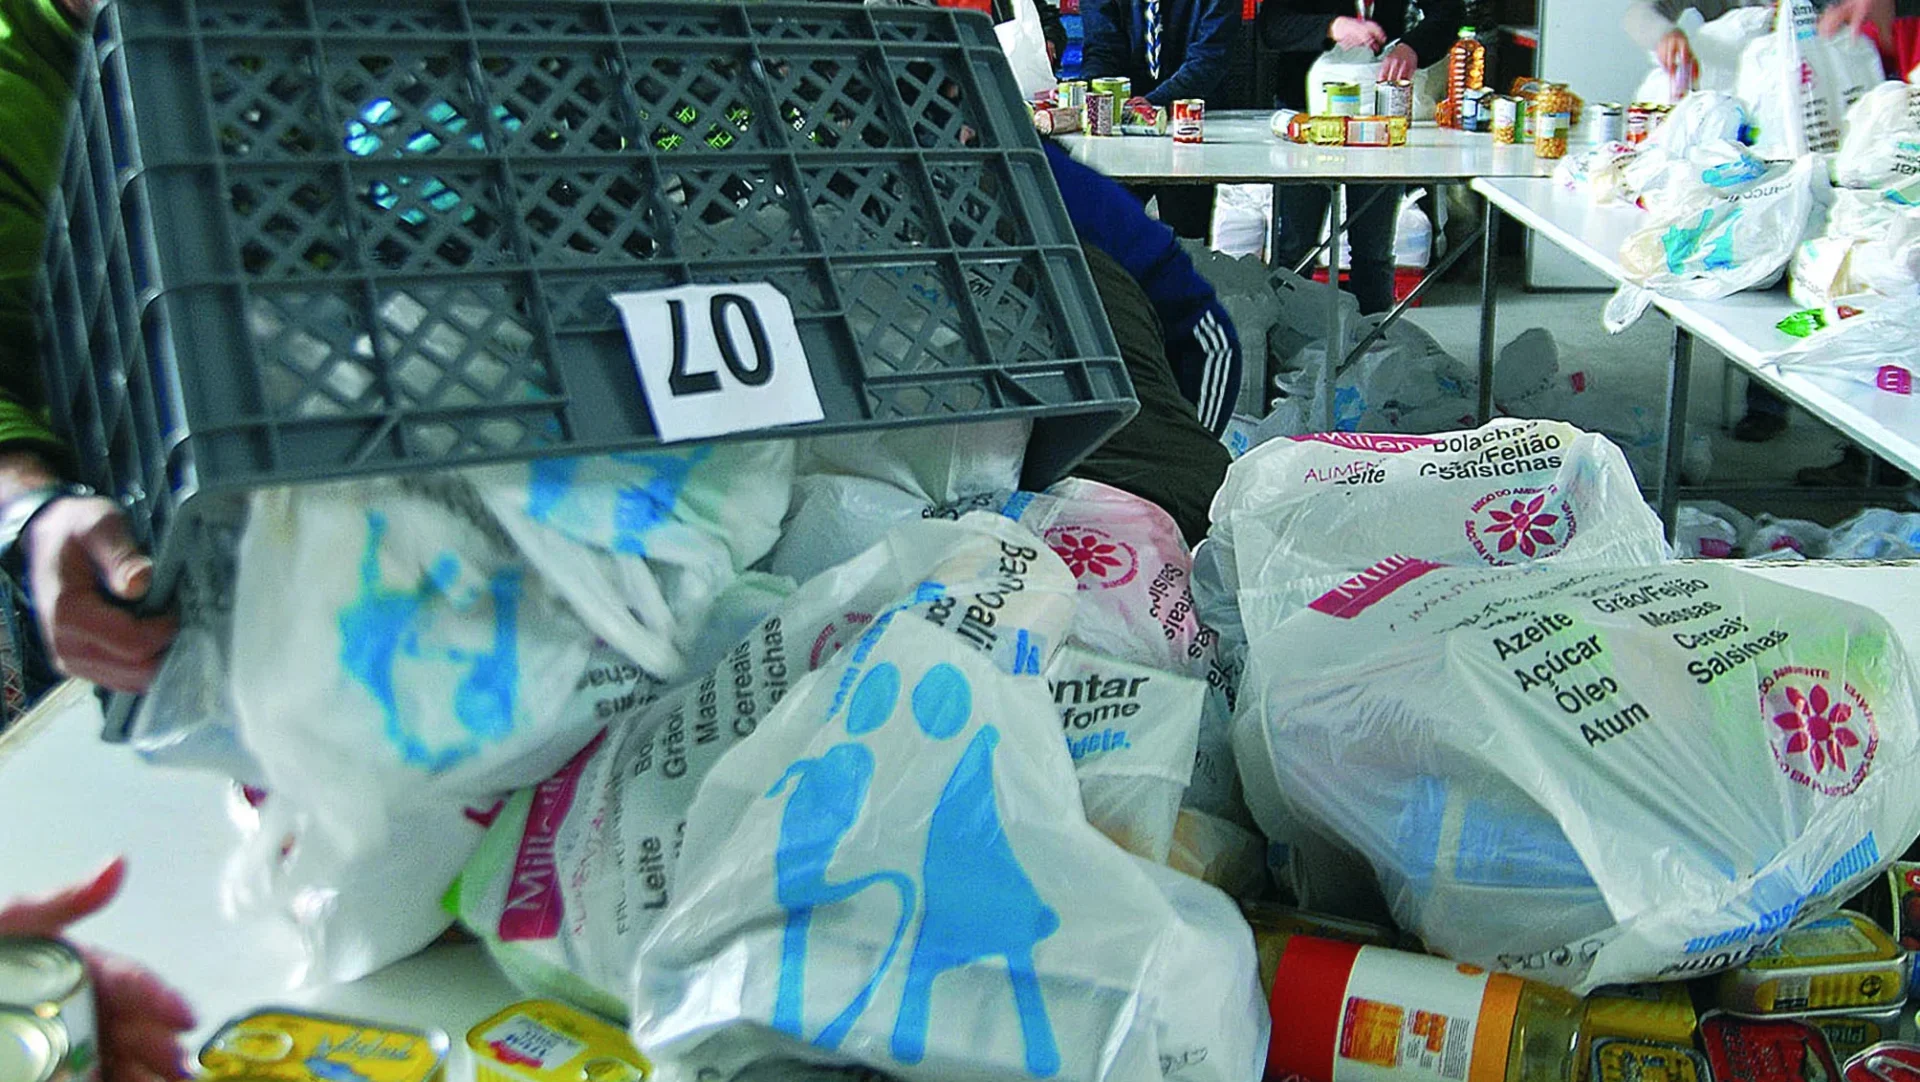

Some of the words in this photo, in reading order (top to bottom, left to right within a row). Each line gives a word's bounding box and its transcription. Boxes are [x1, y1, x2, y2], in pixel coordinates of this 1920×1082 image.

[667, 293, 774, 397] 07
[1334, 467, 1385, 485] eite
[1591, 577, 1710, 614] Grão/Feijão
[1638, 599, 1722, 627] Massas
[1491, 610, 1574, 661] Azeite
[1513, 634, 1604, 692] Açúcar
[728, 639, 758, 738] Cereais
[1048, 673, 1150, 704] ntar
[1553, 675, 1619, 715] Óleo
[1062, 702, 1141, 731] fome
[1579, 702, 1651, 747] Atum
[639, 835, 669, 910] Leite
